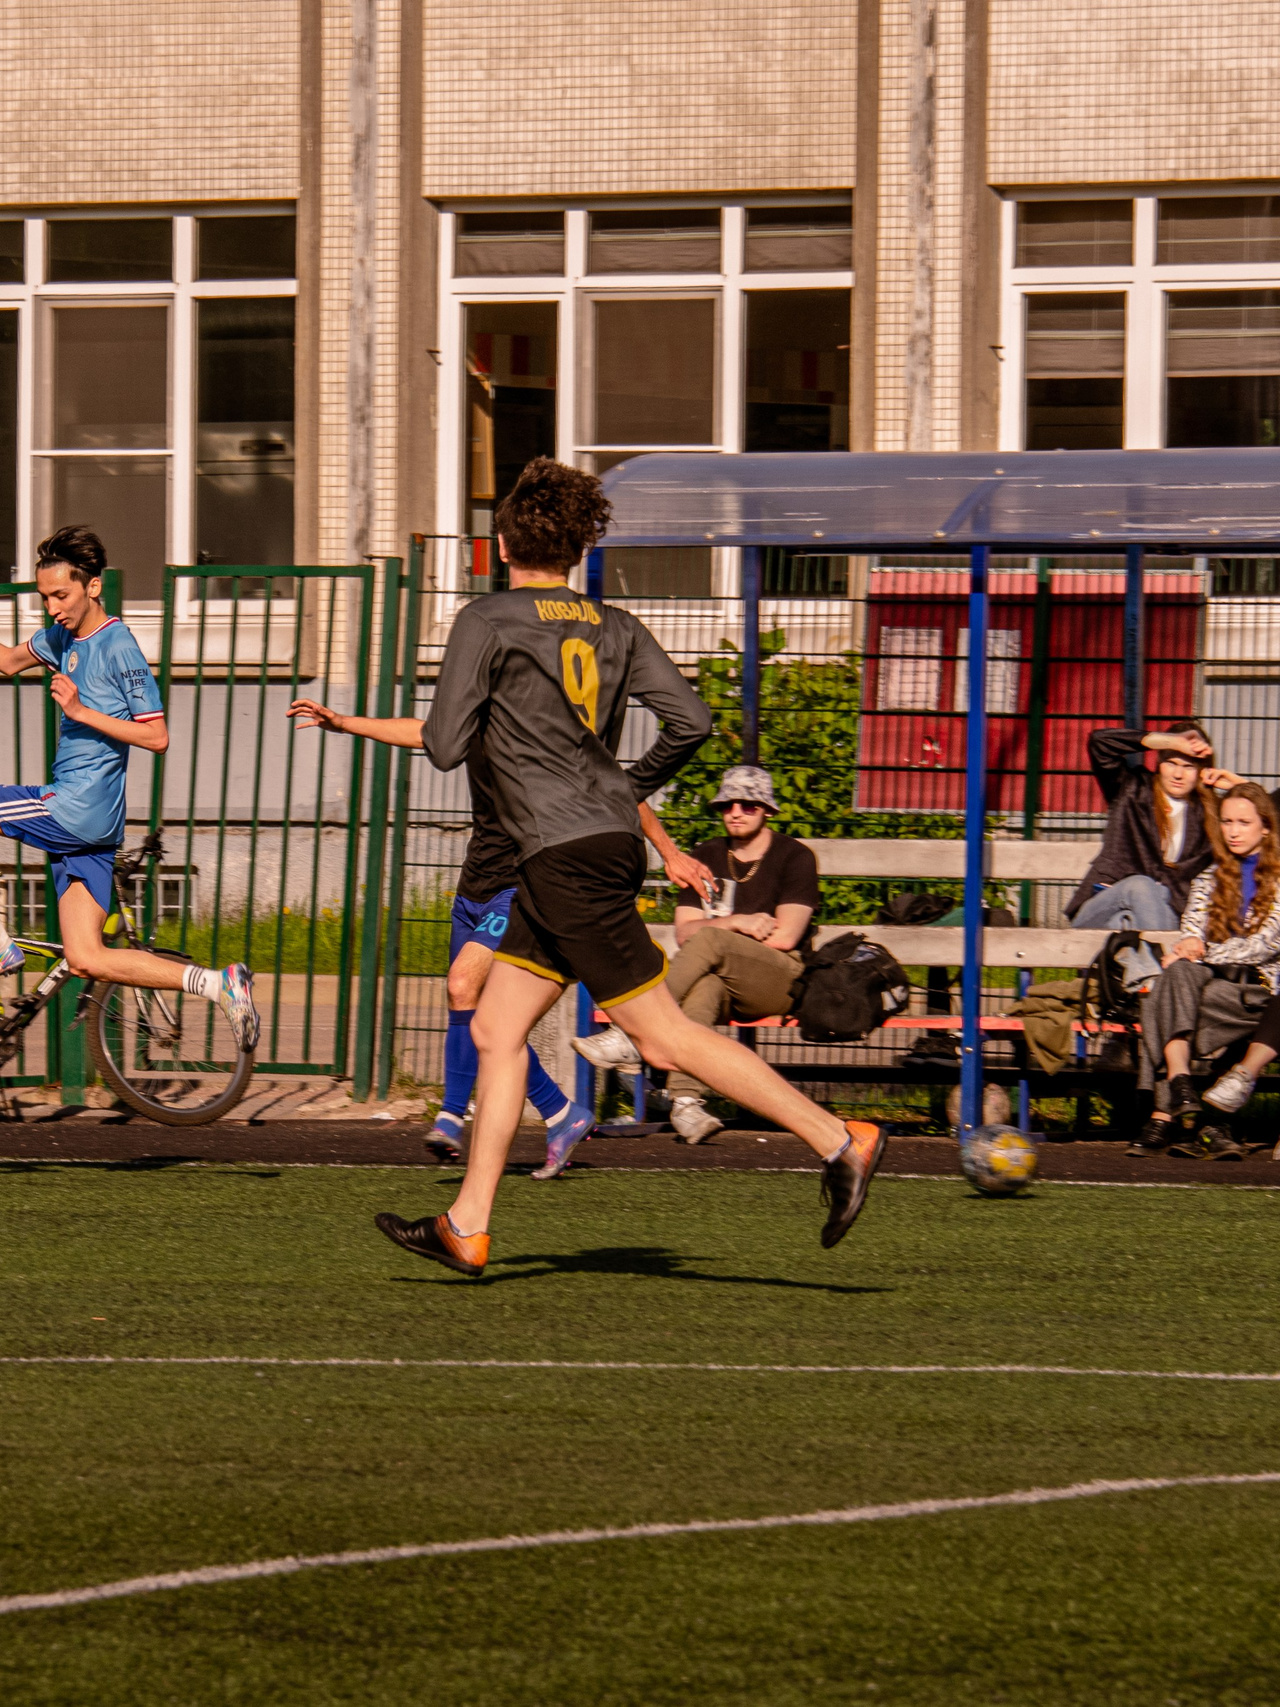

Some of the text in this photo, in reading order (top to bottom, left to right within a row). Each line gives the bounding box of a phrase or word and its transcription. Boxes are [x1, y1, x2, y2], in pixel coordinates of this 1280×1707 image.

[120, 668, 148, 679] NEXEN
[128, 678, 146, 687] TIRE
[561, 638, 600, 735] 9
[474, 912, 508, 937] 20
